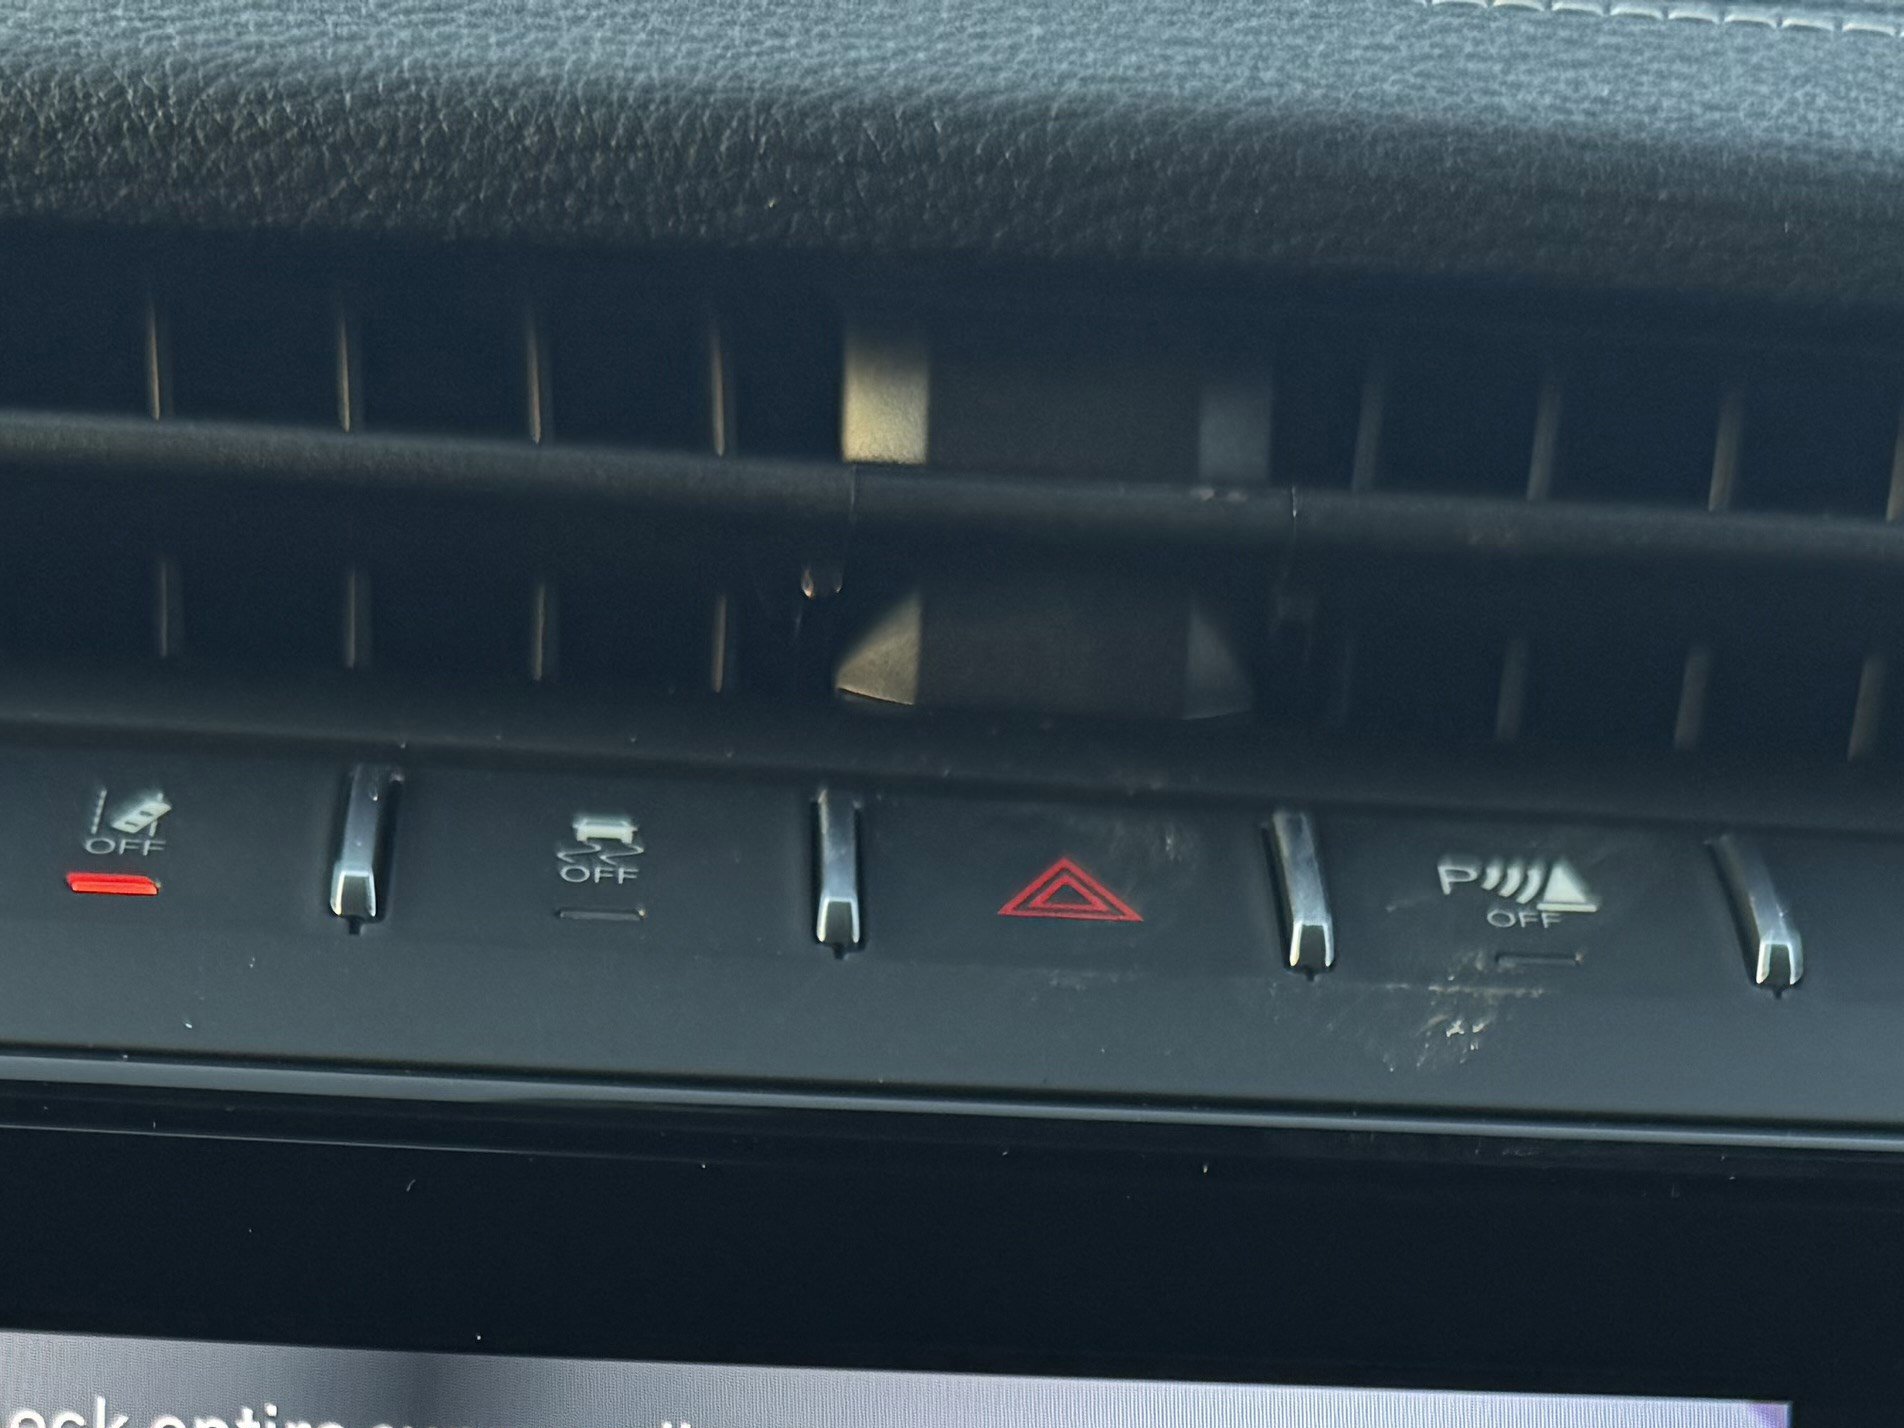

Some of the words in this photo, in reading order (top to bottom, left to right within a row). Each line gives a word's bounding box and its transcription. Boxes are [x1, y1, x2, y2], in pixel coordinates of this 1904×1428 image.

[84, 837, 167, 857] OFF
[559, 865, 639, 885] OFF
[1486, 908, 1562, 929] OFF
